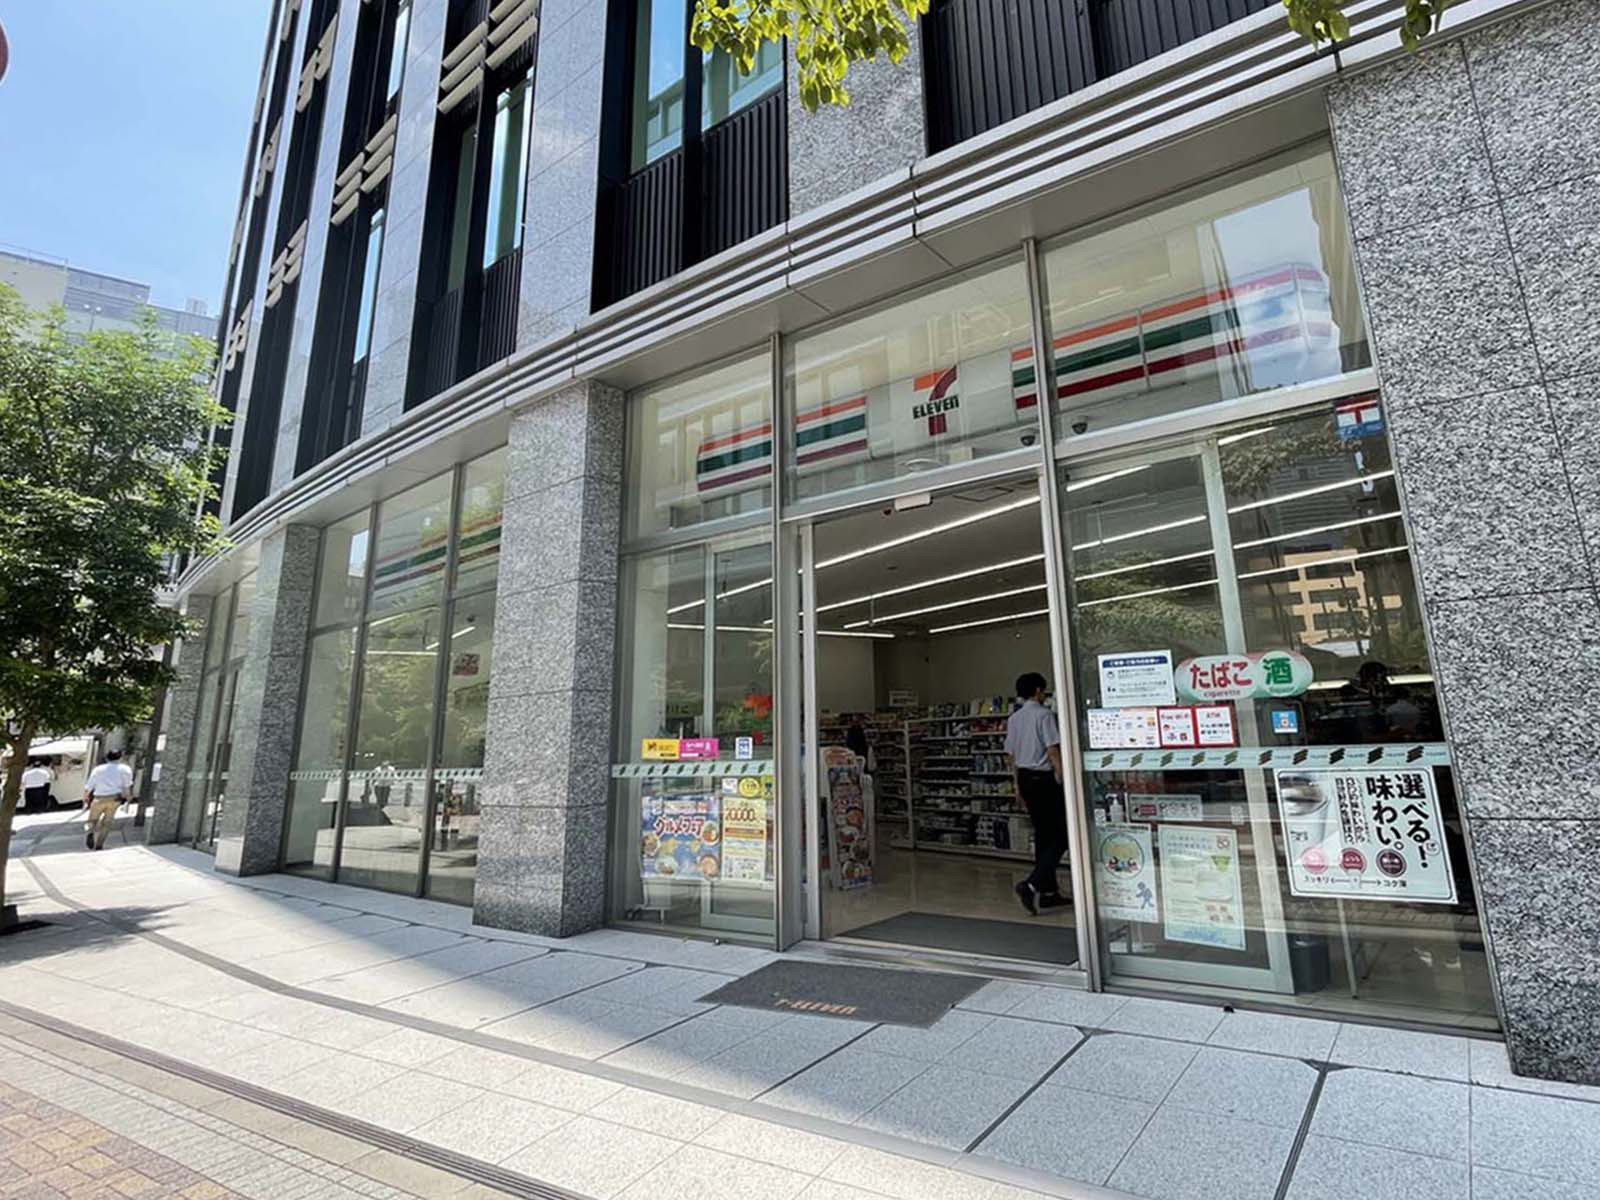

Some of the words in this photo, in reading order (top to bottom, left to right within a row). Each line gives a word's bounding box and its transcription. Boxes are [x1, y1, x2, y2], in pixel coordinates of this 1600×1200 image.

[1190, 661, 1253, 689] たばこ
[1263, 657, 1292, 684] 酒
[1365, 774, 1405, 851] 味わい。
